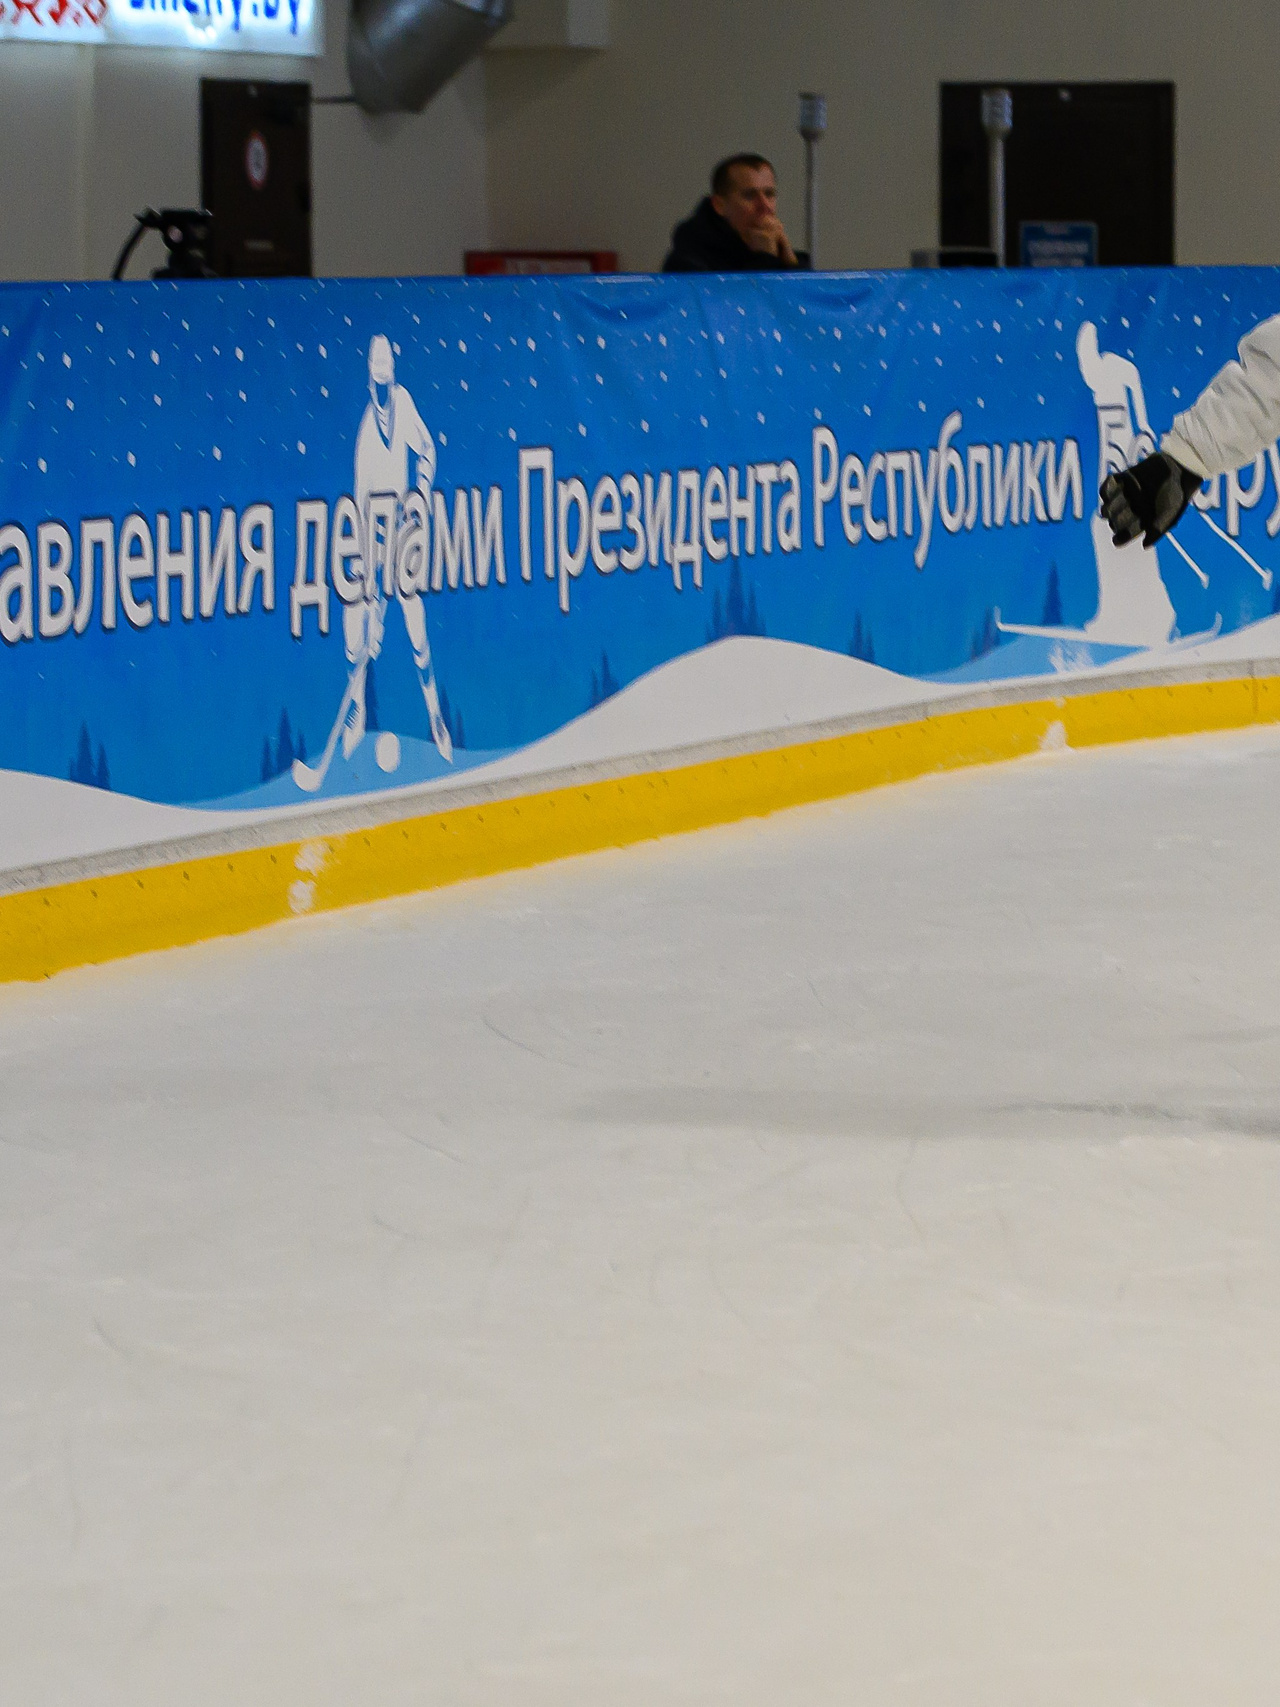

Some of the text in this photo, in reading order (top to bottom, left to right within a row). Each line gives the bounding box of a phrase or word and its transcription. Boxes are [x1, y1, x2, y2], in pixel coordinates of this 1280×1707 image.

[0, 504, 275, 643] авления
[290, 485, 507, 638] делами
[518, 446, 802, 613] Президента
[812, 409, 1084, 570] Республики
